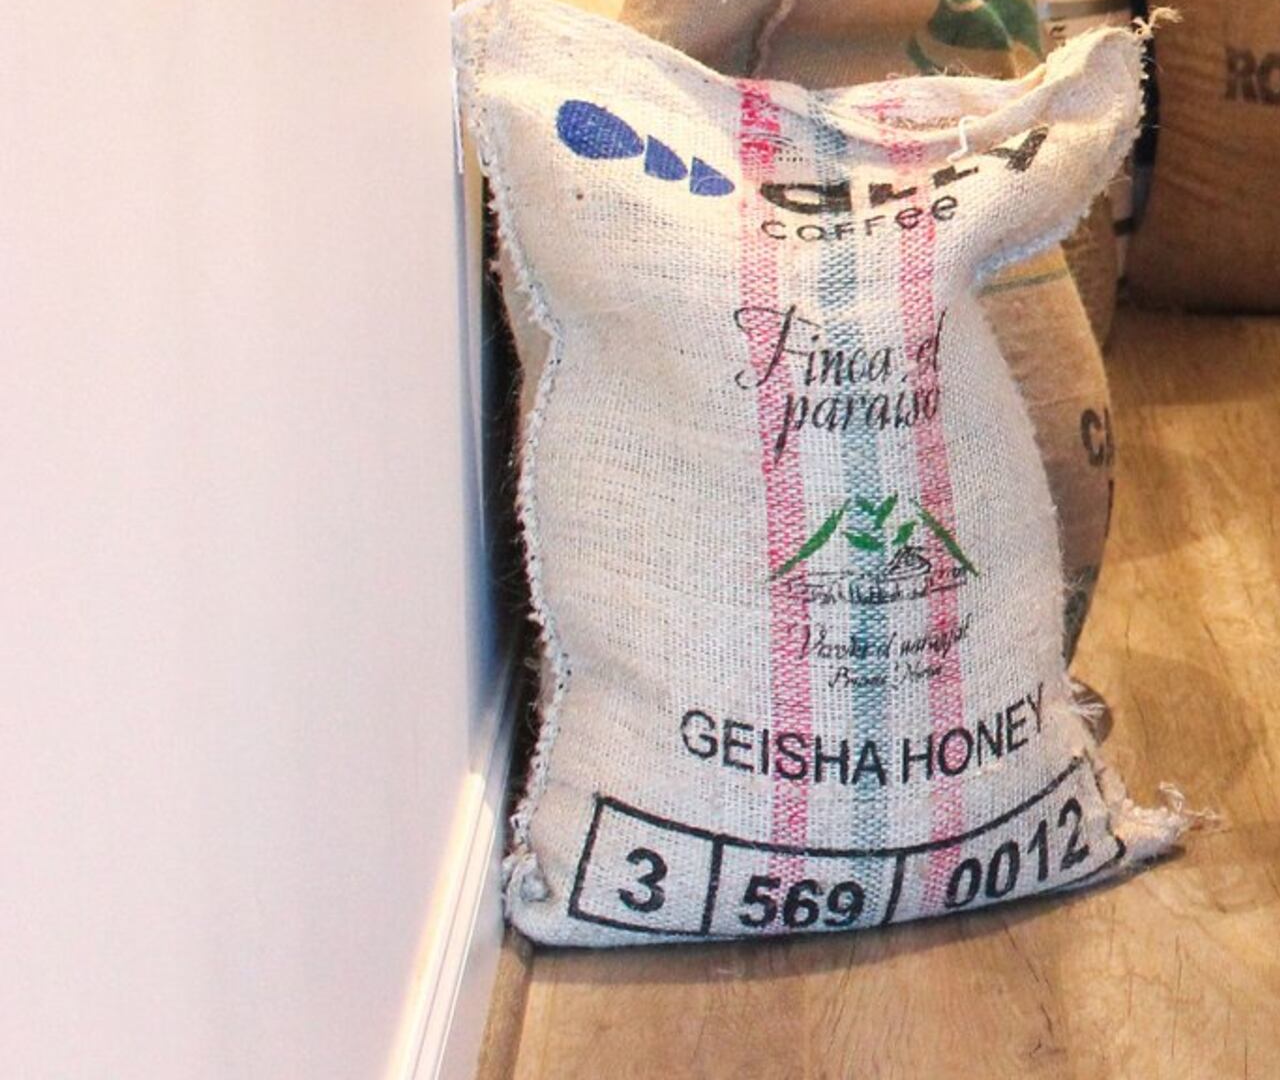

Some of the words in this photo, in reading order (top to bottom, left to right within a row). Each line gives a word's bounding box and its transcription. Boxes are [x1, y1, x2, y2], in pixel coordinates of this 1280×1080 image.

[734, 304, 892, 390] Finca
[680, 709, 888, 787] GEISHA
[902, 683, 1043, 784] HONEY
[617, 846, 669, 913] 3
[738, 875, 866, 929] 569
[945, 797, 1091, 910] 0012
